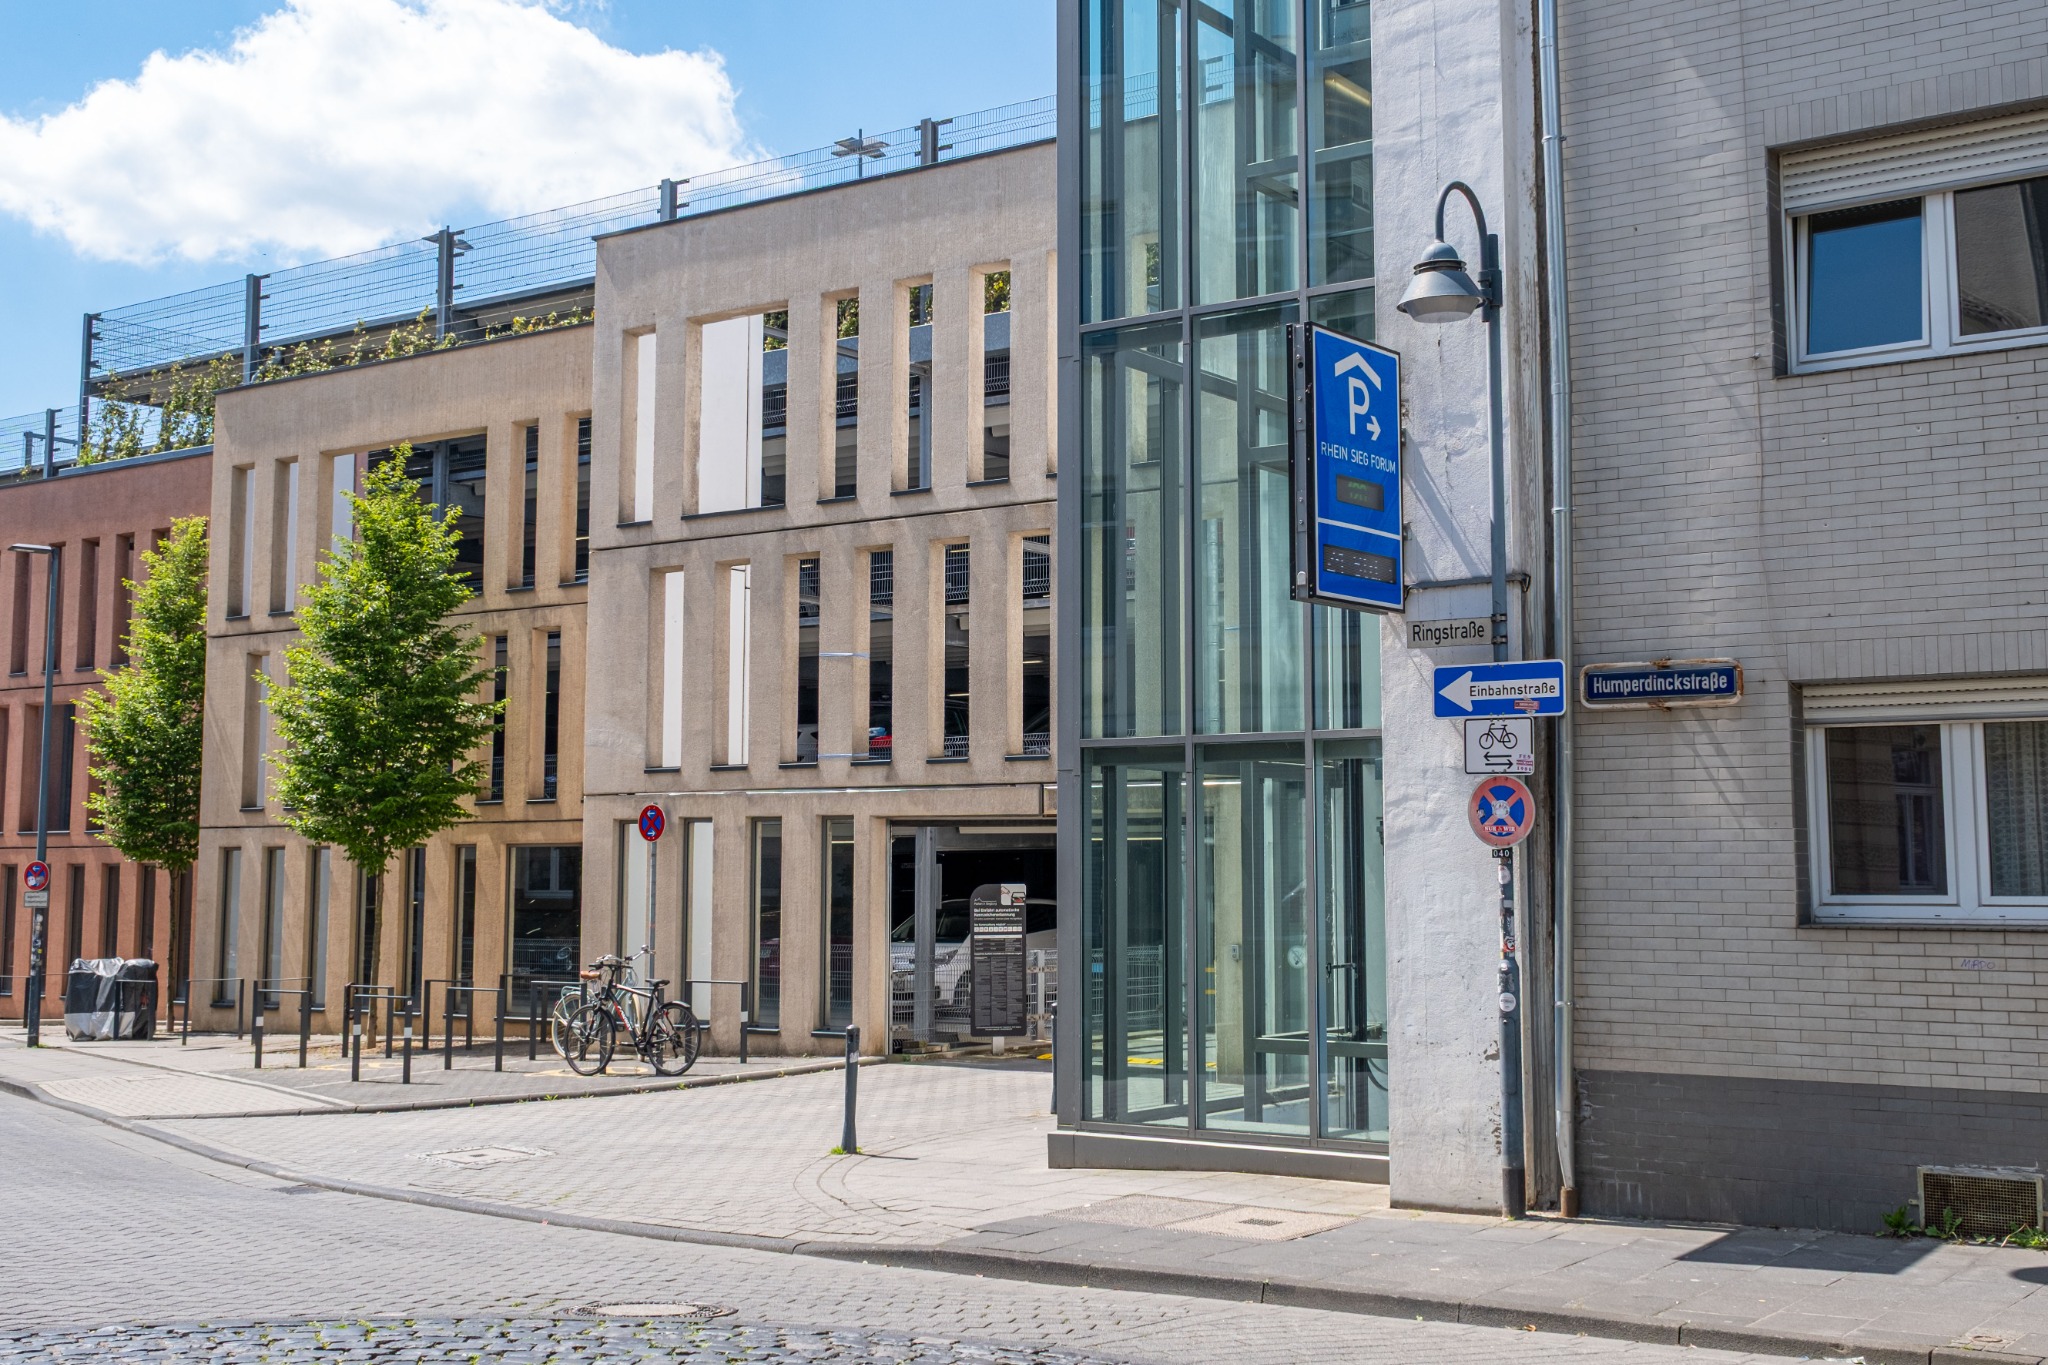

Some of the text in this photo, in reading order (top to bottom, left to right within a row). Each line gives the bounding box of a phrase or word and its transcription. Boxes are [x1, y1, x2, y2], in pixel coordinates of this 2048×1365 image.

[1320, 441, 1396, 475] RHEIN SIEG FORUM
[1412, 621, 1485, 645] Ringstraße
[1469, 682, 1556, 697] Einbahnstraße
[1593, 671, 1728, 696] Humperdinckstraße
[1493, 849, 1510, 857] 040
